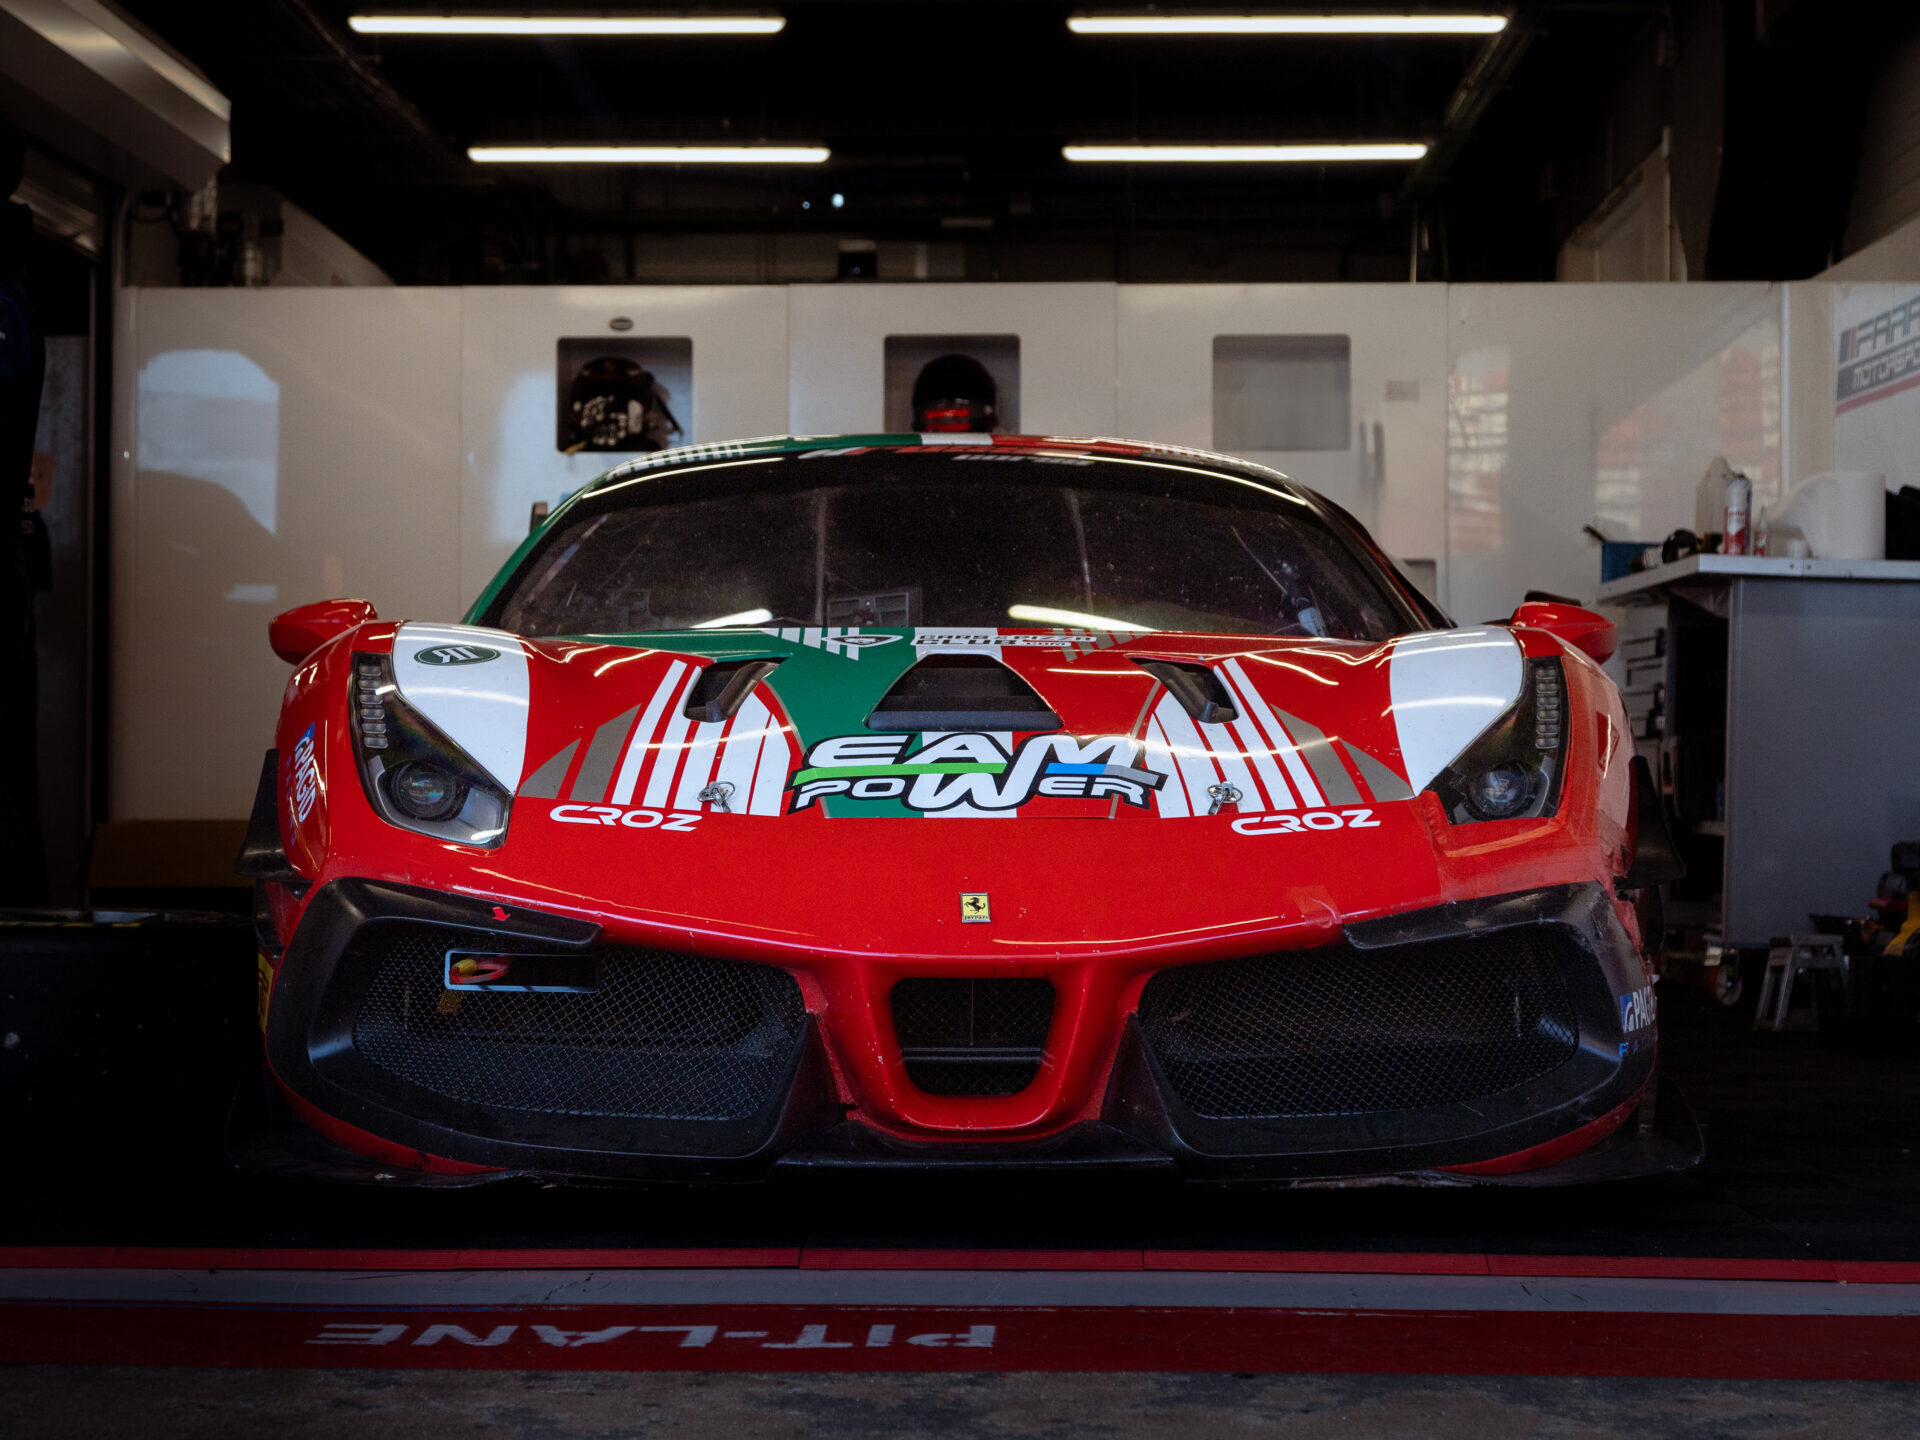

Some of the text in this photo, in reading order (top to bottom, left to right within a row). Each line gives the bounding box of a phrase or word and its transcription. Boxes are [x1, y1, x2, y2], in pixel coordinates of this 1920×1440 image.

[295, 740, 315, 823] PAGID
[795, 771, 1146, 812] POWER
[550, 804, 702, 832] CROZ
[1231, 808, 1381, 836] CROZ
[303, 1323, 997, 1348] PIT-LANE
